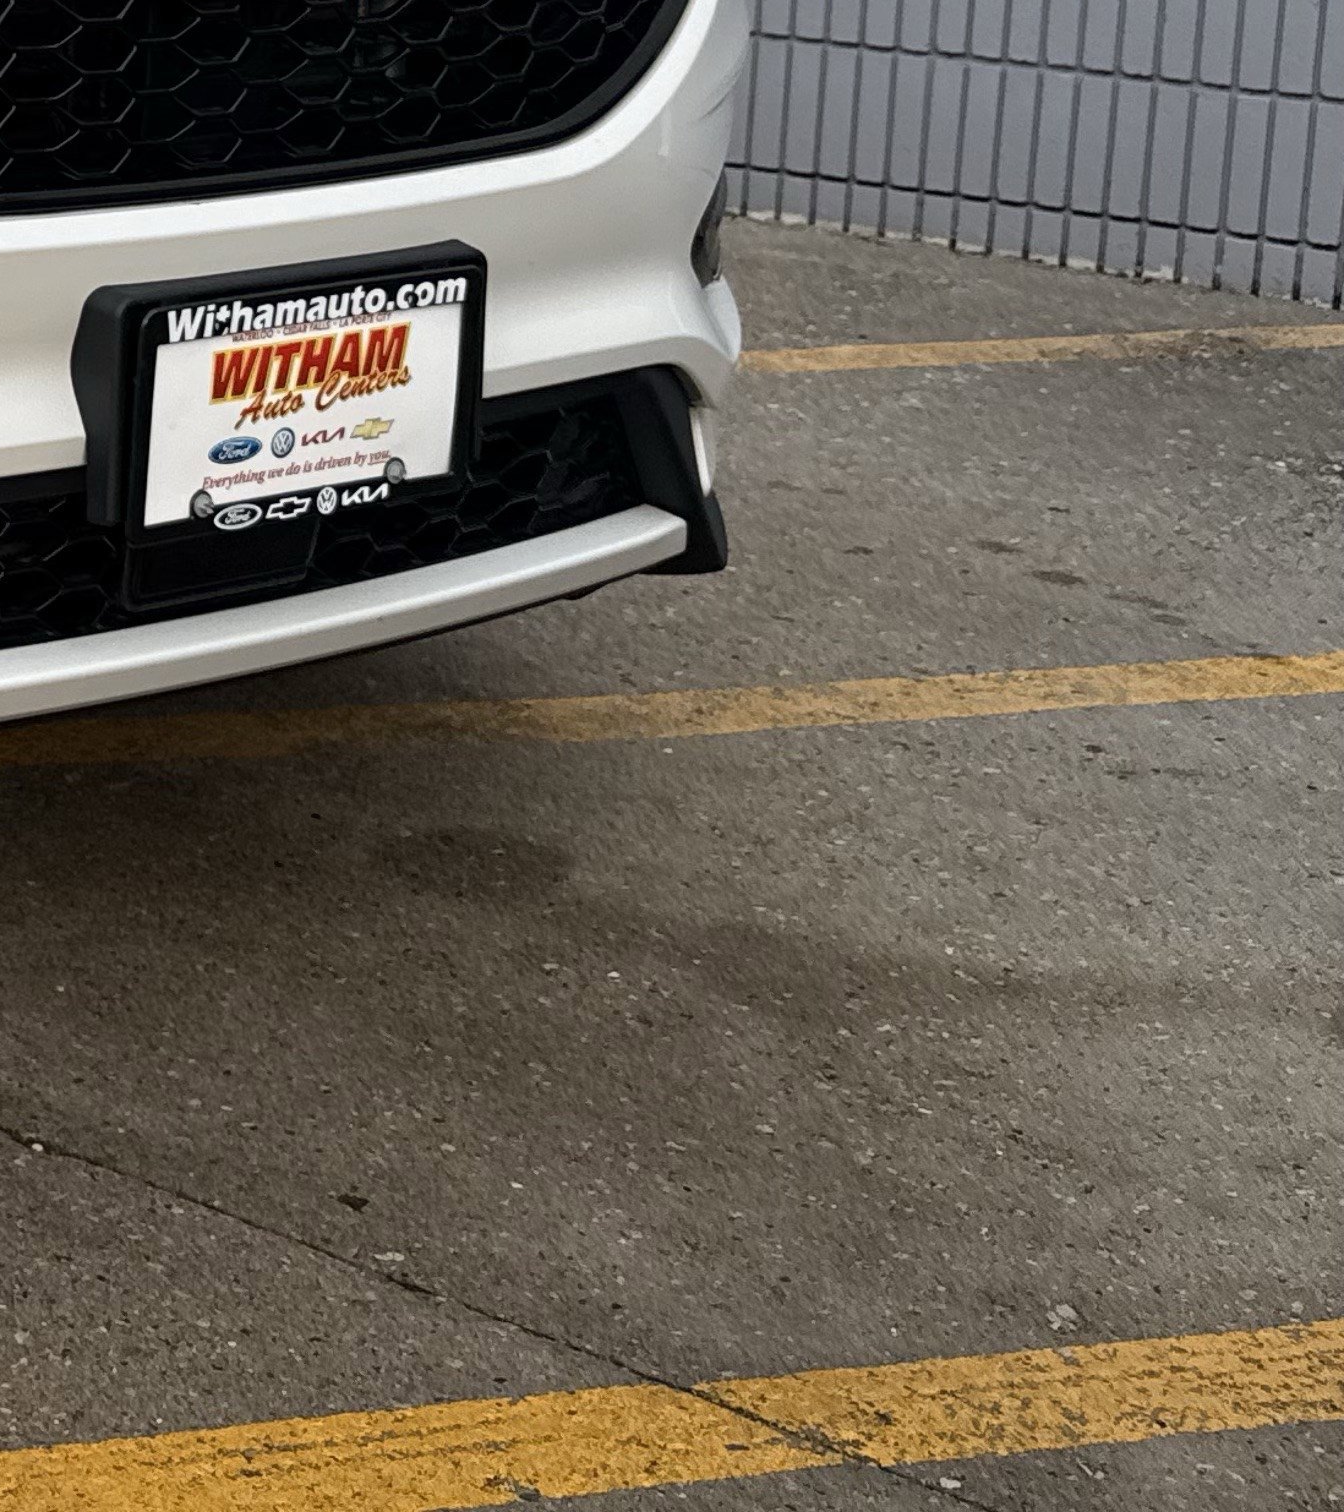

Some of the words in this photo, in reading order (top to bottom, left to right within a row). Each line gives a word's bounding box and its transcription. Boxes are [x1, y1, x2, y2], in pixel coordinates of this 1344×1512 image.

[167, 276, 468, 344] Withamauto.com
[210, 321, 410, 405] WITHAM
[233, 388, 305, 430] Auto
[315, 365, 412, 412] Centers
[202, 467, 266, 490] Everything
[267, 467, 283, 479] we
[285, 461, 301, 477] do
[303, 460, 312, 473] is
[314, 453, 352, 472] driven
[353, 451, 366, 467] by
